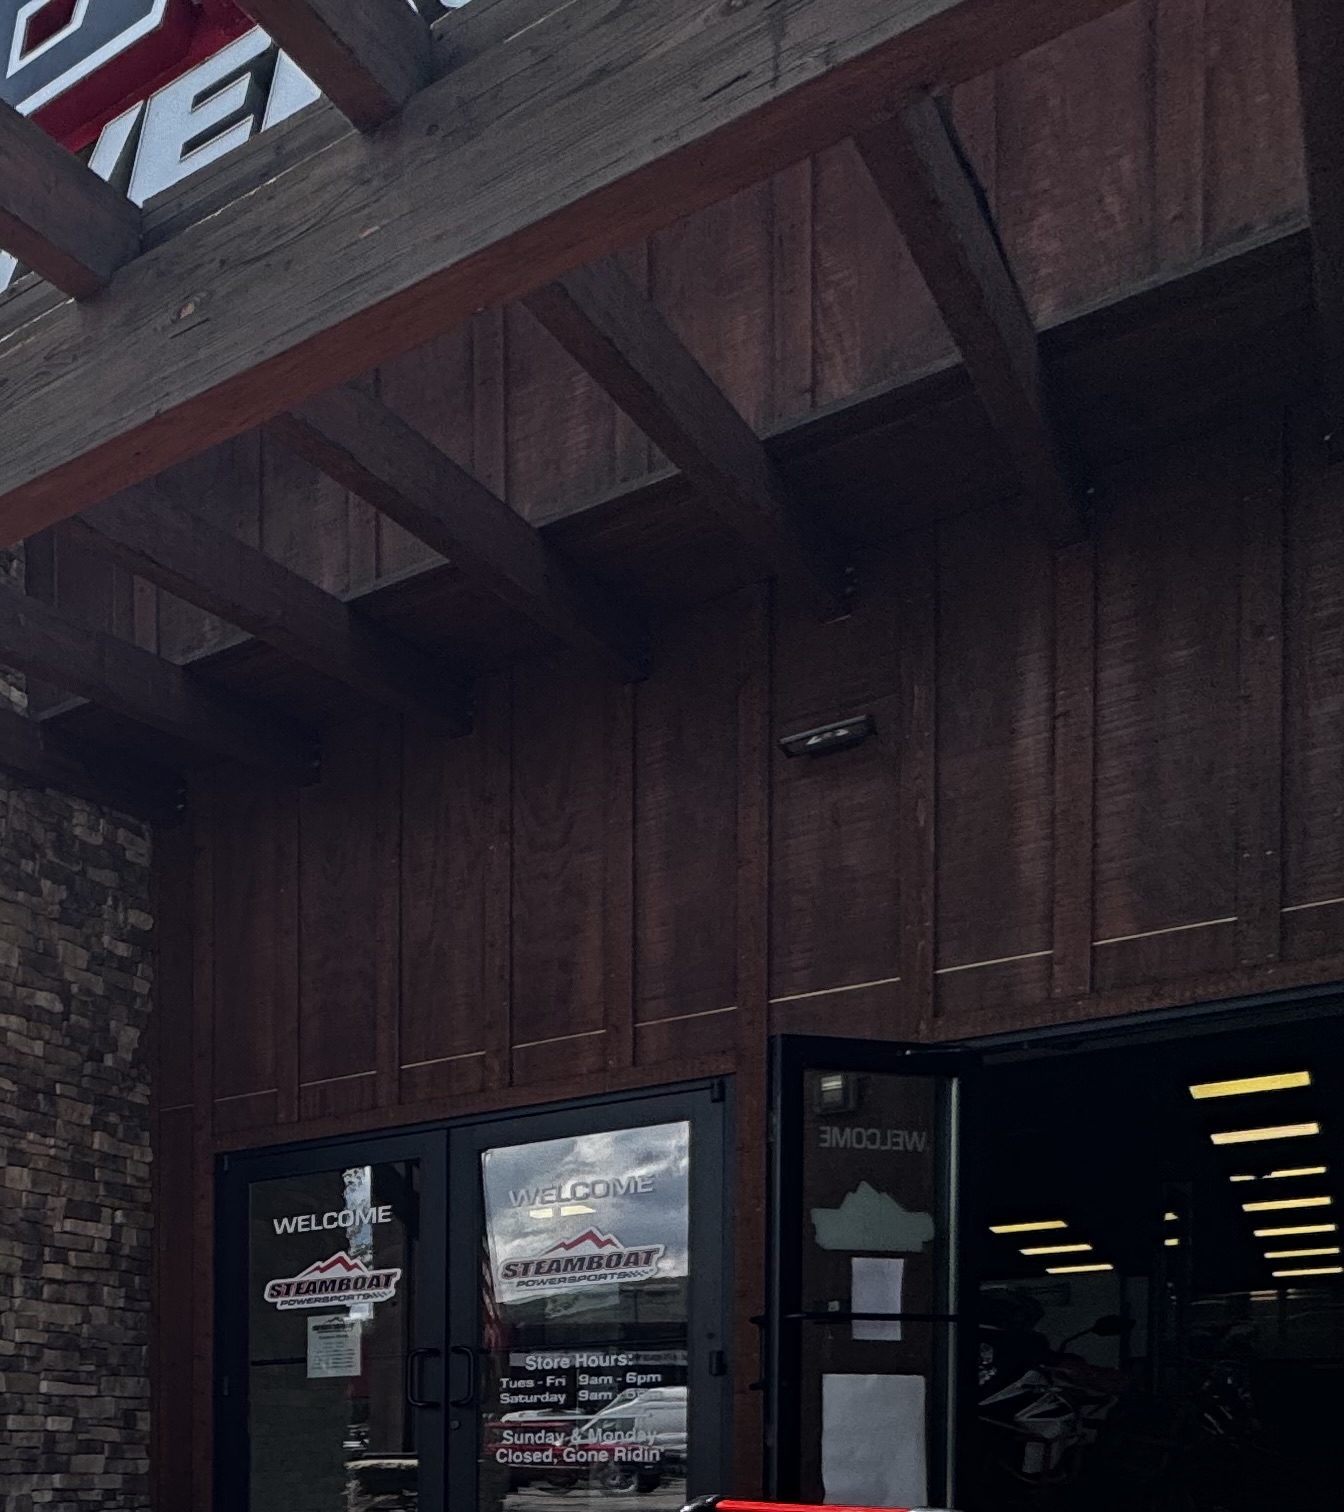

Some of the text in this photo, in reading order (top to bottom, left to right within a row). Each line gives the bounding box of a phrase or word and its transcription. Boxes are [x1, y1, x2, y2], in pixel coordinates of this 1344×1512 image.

[509, 1174, 657, 1207] WELCOME
[273, 1205, 392, 1235] WELCOME
[502, 1248, 661, 1280] STEAMBOAT
[269, 1272, 398, 1299] STEAMBOAT
[515, 1271, 630, 1288] POWERSPORTS
[280, 1292, 373, 1307] POWERSPORTS
[525, 1353, 634, 1371] Store Hours:
[500, 1377, 535, 1389] Tues
[546, 1375, 566, 1387] Fri
[578, 1373, 612, 1386] 9am
[625, 1371, 662, 1387] 6pm
[499, 1391, 566, 1404] Saturday
[577, 1389, 612, 1401] 9am
[502, 1428, 657, 1448] Sunday & Monday
[495, 1449, 558, 1465] Closed,
[562, 1447, 609, 1463] Gone
